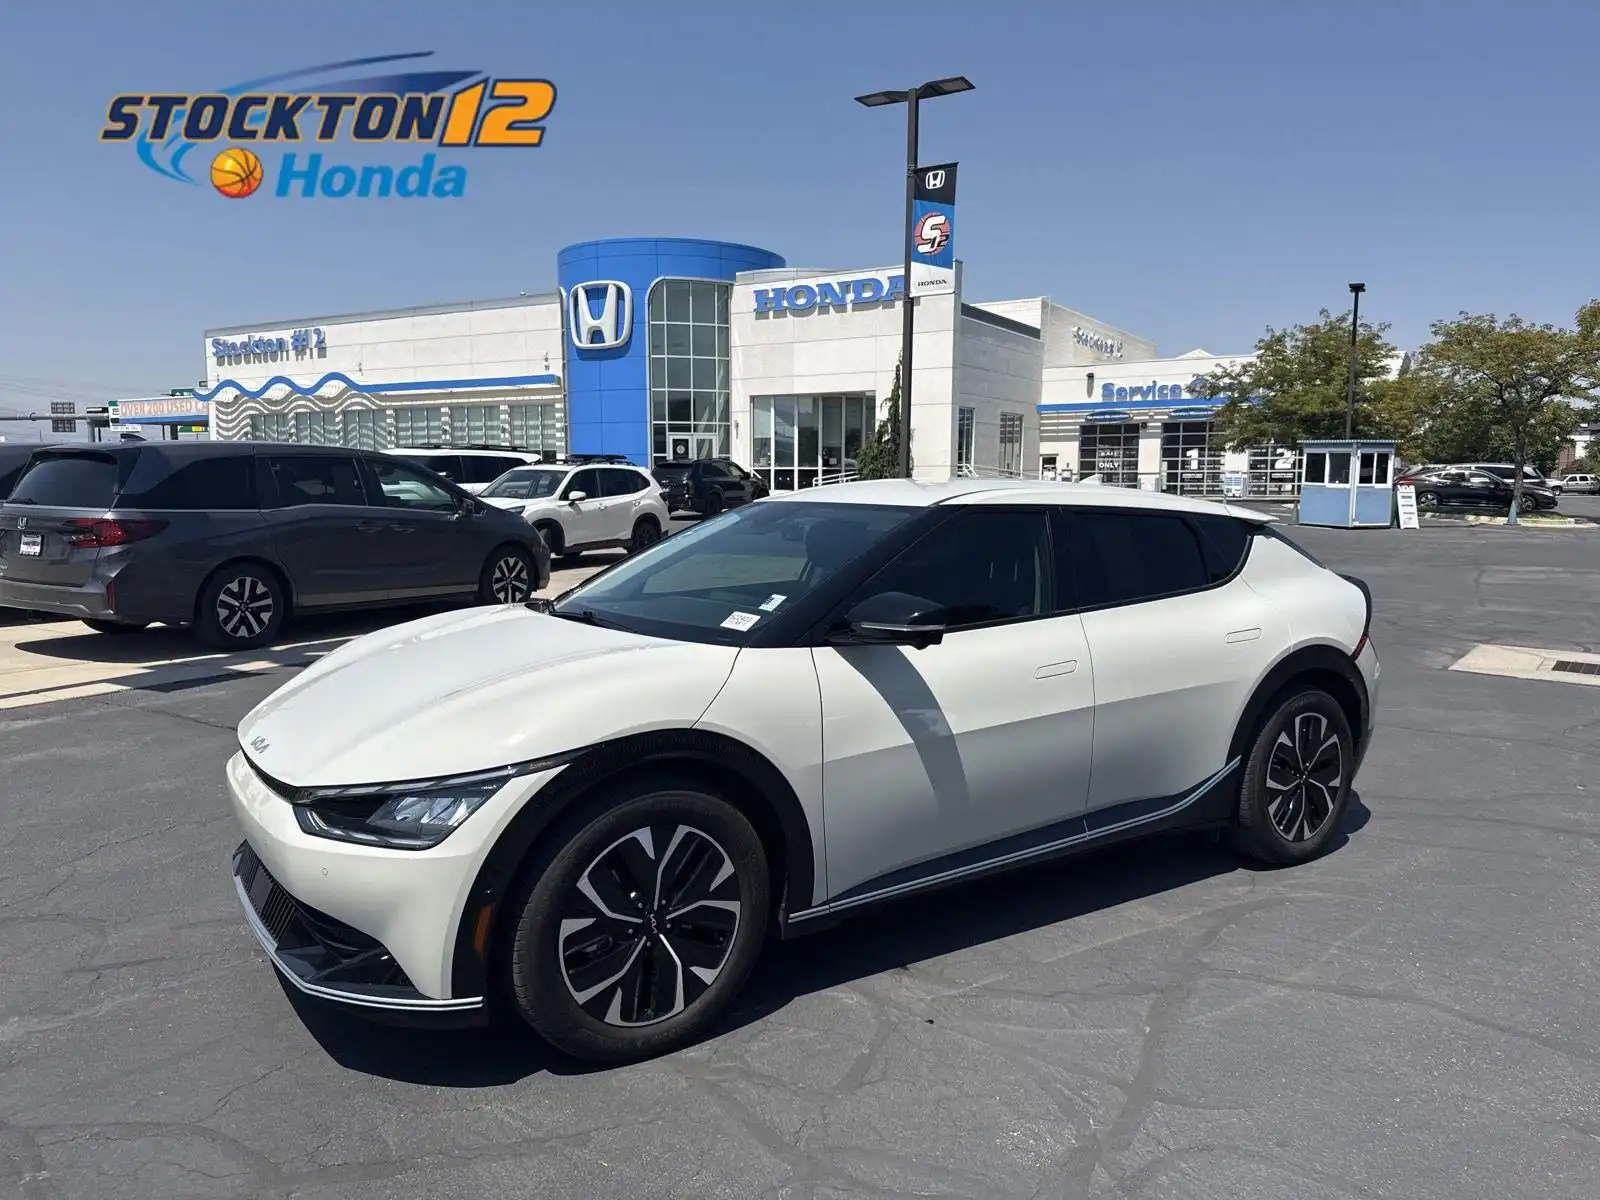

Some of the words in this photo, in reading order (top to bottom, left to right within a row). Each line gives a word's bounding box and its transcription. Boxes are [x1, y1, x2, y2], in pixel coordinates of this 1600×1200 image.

[918, 279, 947, 287] HONDA
[212, 335, 289, 358] Stockton
[291, 328, 327, 349] #12
[1101, 380, 1183, 402] Service
[121, 402, 145, 416] OVER
[147, 401, 165, 414] 200
[167, 399, 192, 413] USED
[1186, 448, 1199, 470] 1
[1274, 448, 1295, 469] 2
